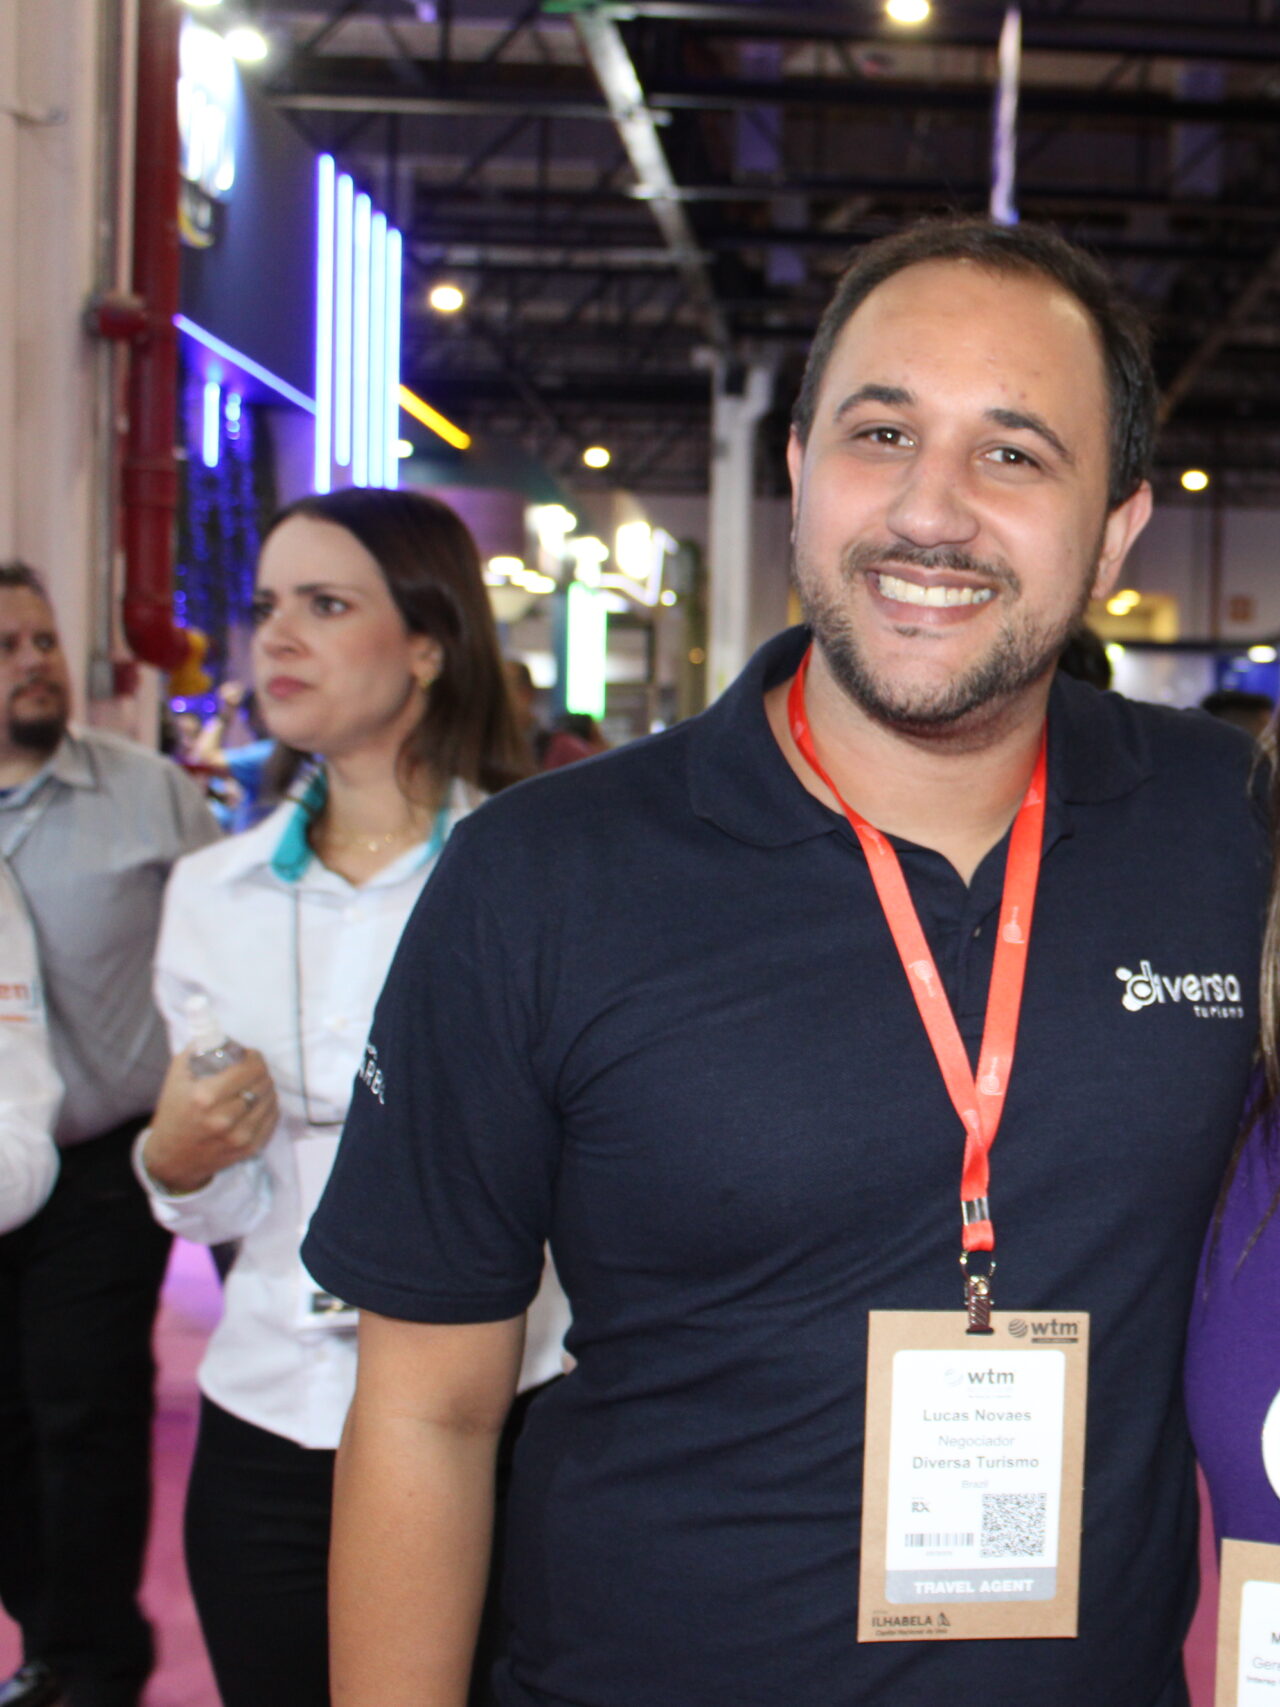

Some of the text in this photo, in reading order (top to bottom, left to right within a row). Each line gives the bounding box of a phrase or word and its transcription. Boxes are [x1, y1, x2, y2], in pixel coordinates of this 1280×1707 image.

[1117, 959, 1241, 1011] diversa
[1031, 1318, 1078, 1336] wtm
[967, 1368, 1015, 1385] wtm
[923, 1408, 1032, 1422] Lucas Novaes
[938, 1434, 1015, 1450] Negociador
[912, 1454, 1040, 1469] Diversa Turismo
[914, 1579, 1035, 1595] TRAVEL AGENT
[872, 1615, 933, 1628] ILHABELA
